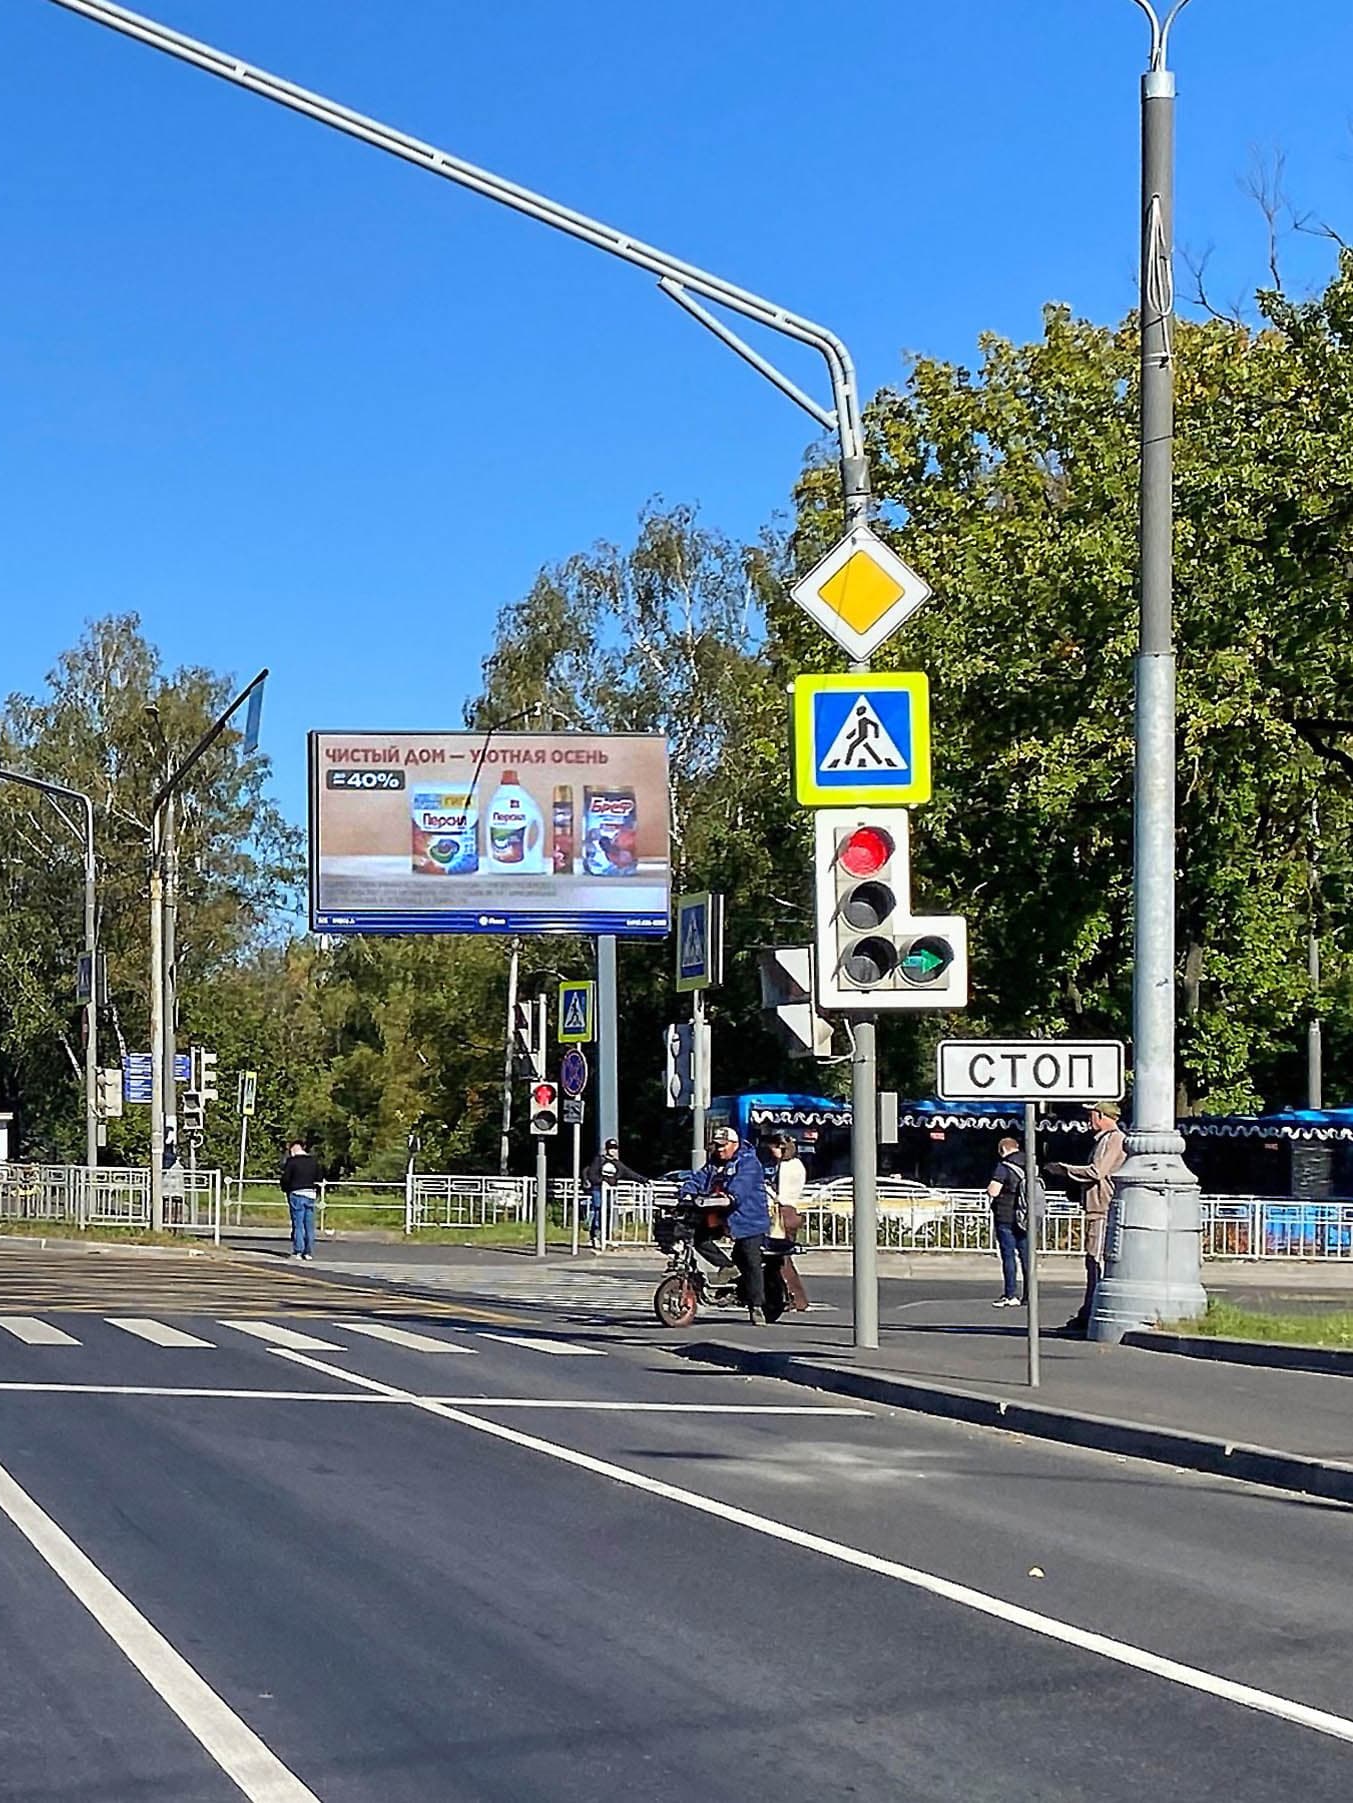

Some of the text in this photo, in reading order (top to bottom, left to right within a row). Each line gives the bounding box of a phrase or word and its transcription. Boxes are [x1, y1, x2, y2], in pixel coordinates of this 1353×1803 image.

[325, 745, 400, 763] ЧИСТЫЙ
[404, 749, 445, 766] ДОМ
[551, 749, 608, 764] ОСЕНЬ
[968, 1053, 1094, 1089] СТОП
